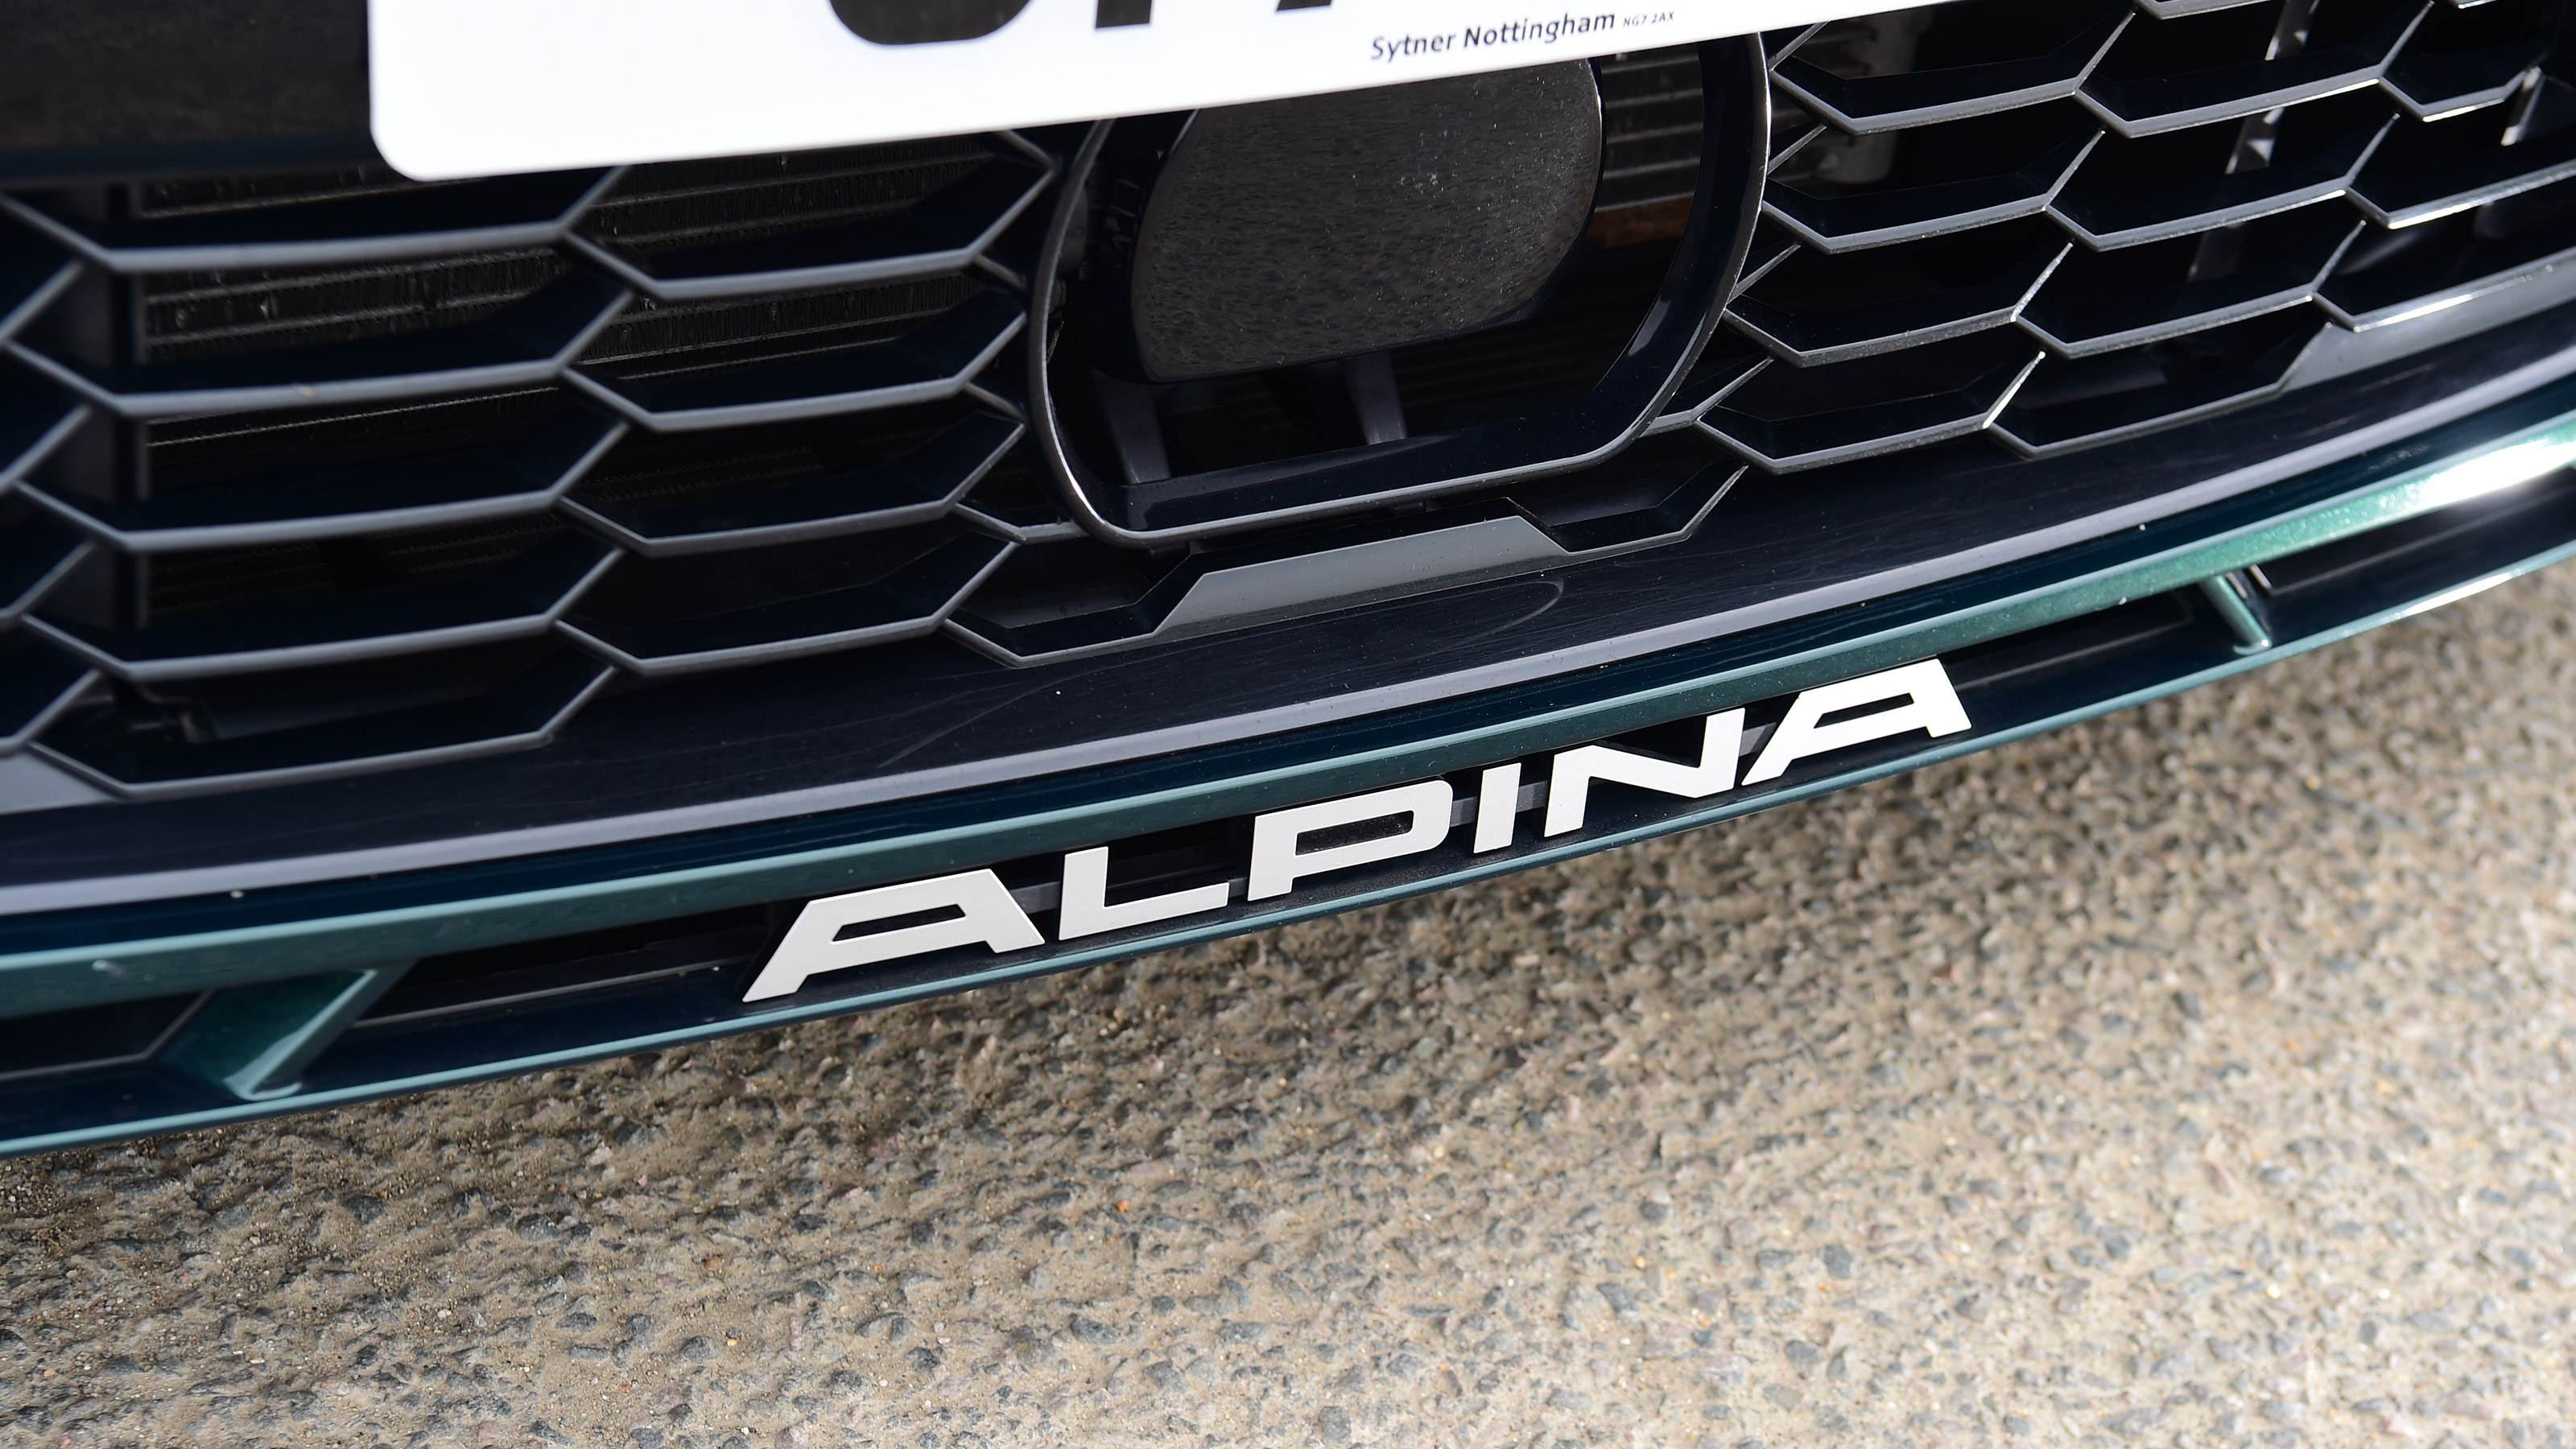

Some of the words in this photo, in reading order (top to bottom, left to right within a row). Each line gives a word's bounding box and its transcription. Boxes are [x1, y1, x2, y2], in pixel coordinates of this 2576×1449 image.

[1370, 34, 1456, 63] Sytner
[1463, 12, 1616, 48] Nottingham
[742, 658, 1971, 1002] ALPINA
